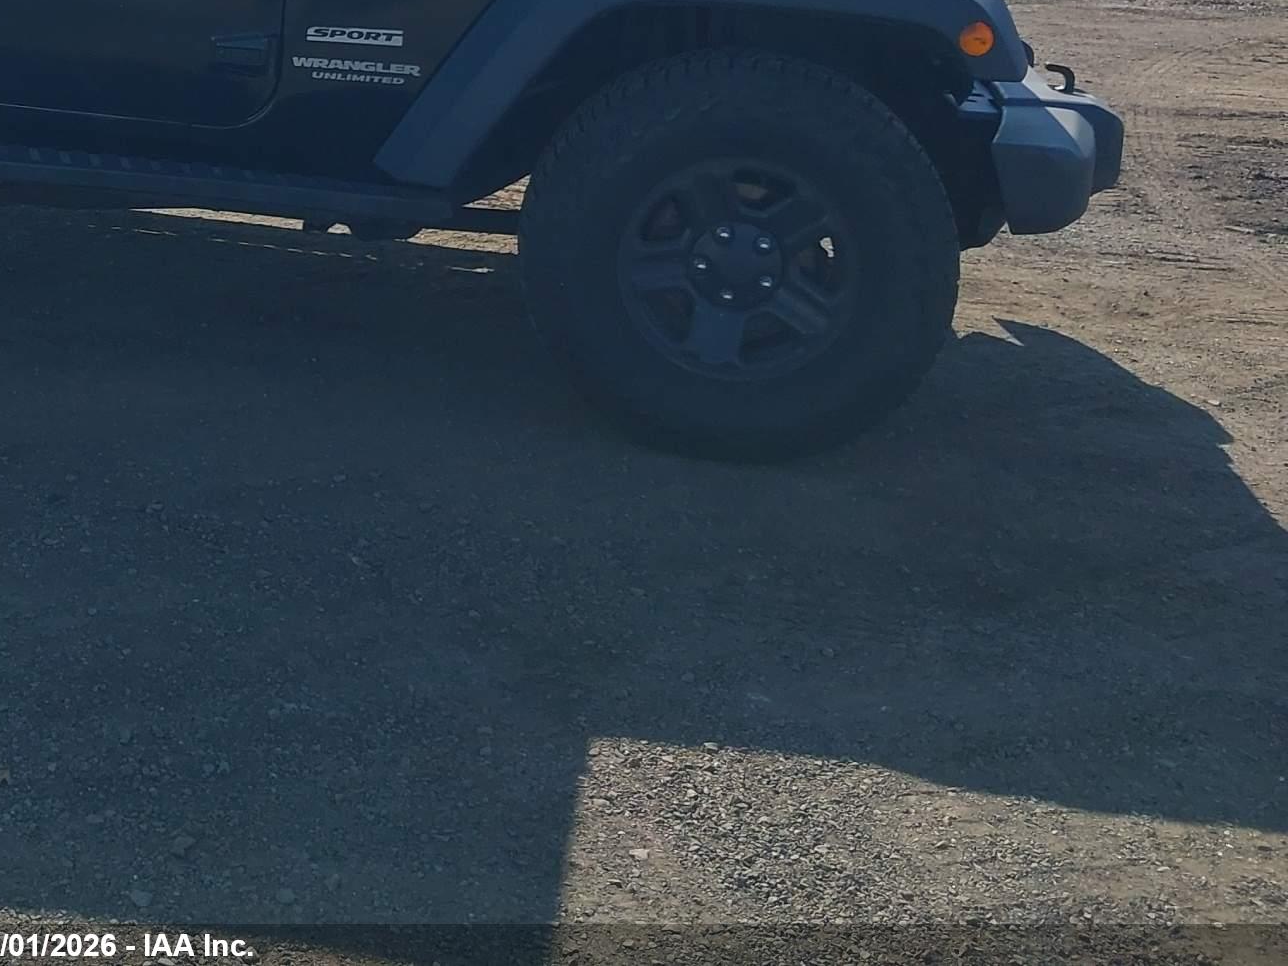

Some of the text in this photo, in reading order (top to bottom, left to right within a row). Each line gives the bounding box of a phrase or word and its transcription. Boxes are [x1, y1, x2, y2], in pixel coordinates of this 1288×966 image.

[307, 27, 404, 45] SPORT
[292, 56, 422, 77] WRANGLER
[312, 70, 406, 85] UNLIMITED
